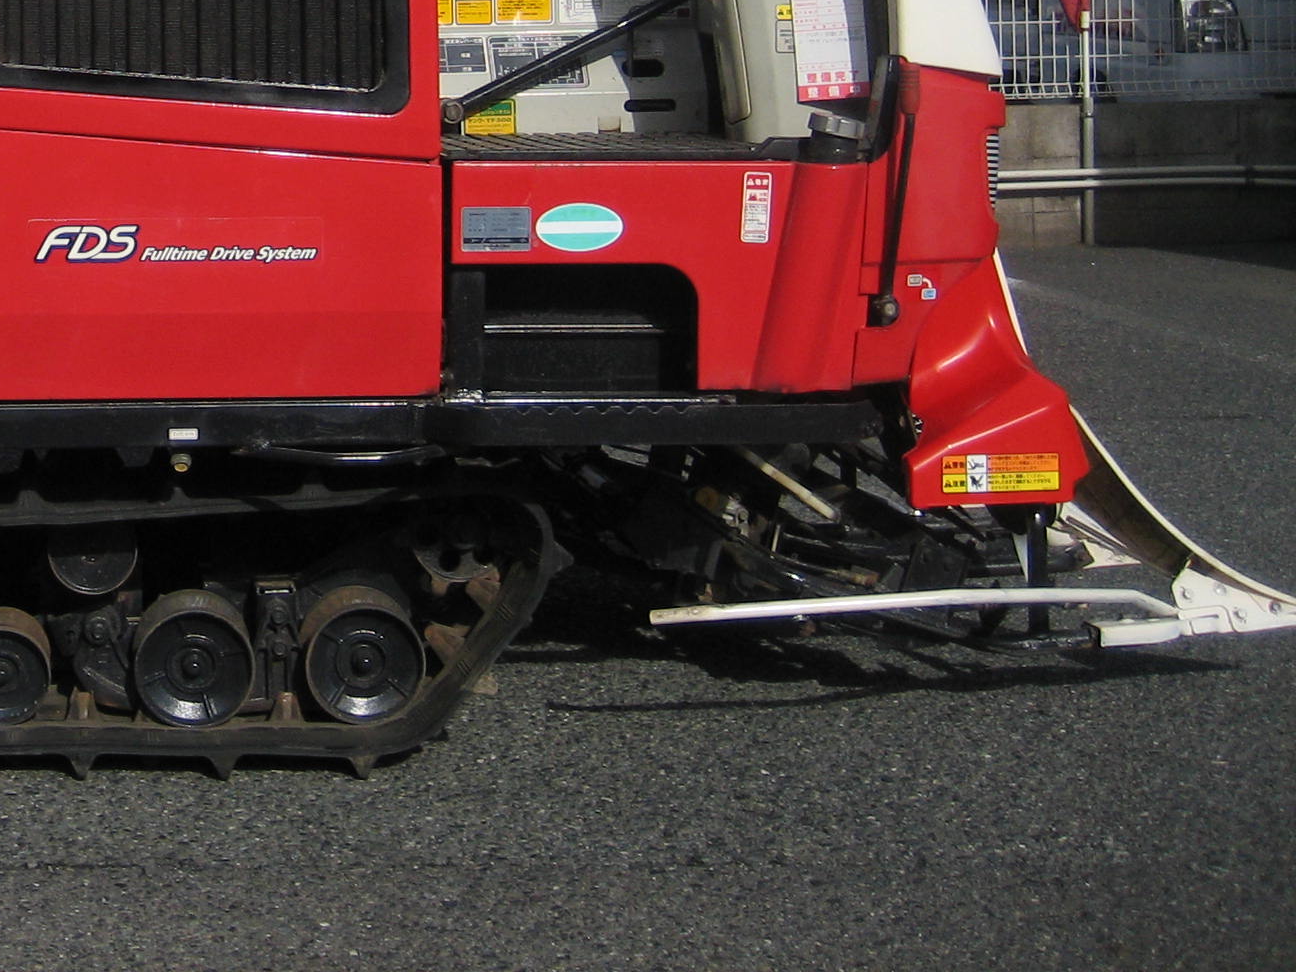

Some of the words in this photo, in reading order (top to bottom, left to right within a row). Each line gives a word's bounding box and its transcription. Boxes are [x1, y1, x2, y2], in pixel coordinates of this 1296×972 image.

[36, 226, 137, 261] FDS
[141, 247, 207, 261] Fulltime
[210, 246, 254, 260] Drive
[256, 245, 317, 262] System
